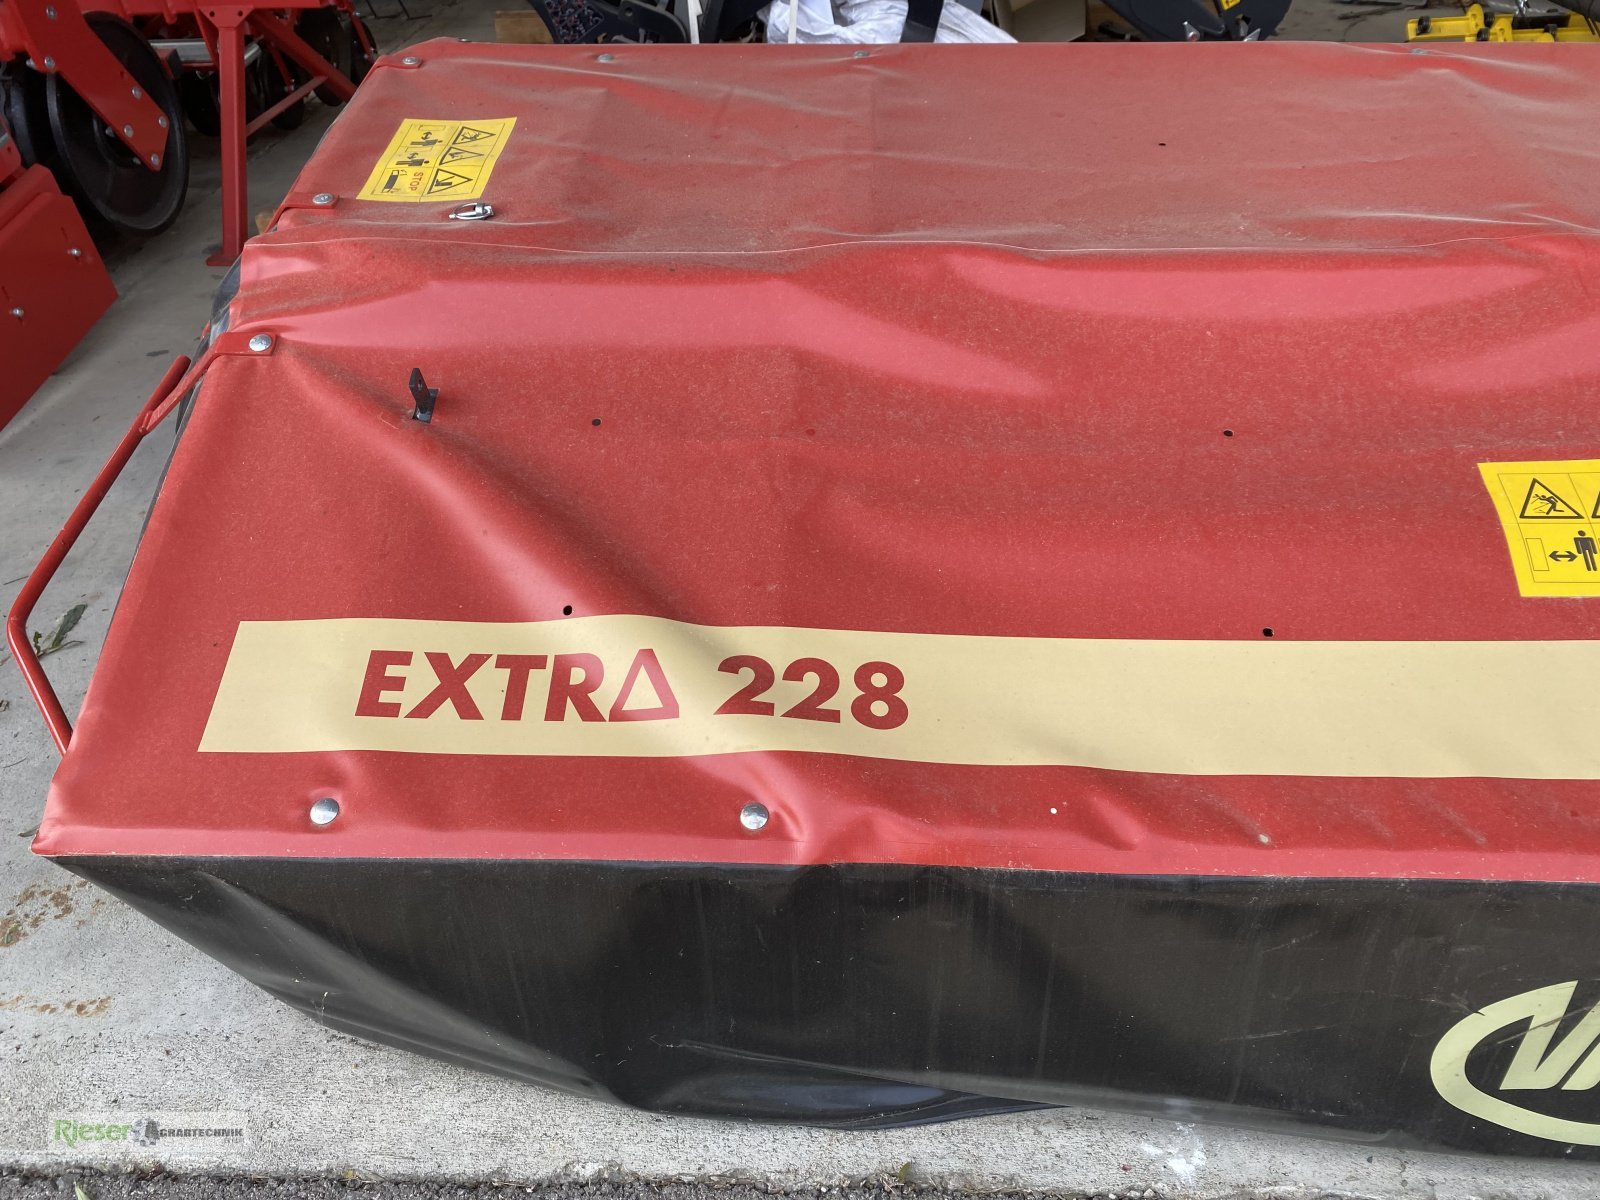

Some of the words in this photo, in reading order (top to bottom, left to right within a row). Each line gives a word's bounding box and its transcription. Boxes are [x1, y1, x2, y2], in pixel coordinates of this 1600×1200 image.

[408, 171, 424, 191] STOP
[354, 648, 680, 722] EXTRA
[713, 655, 909, 730] 228
